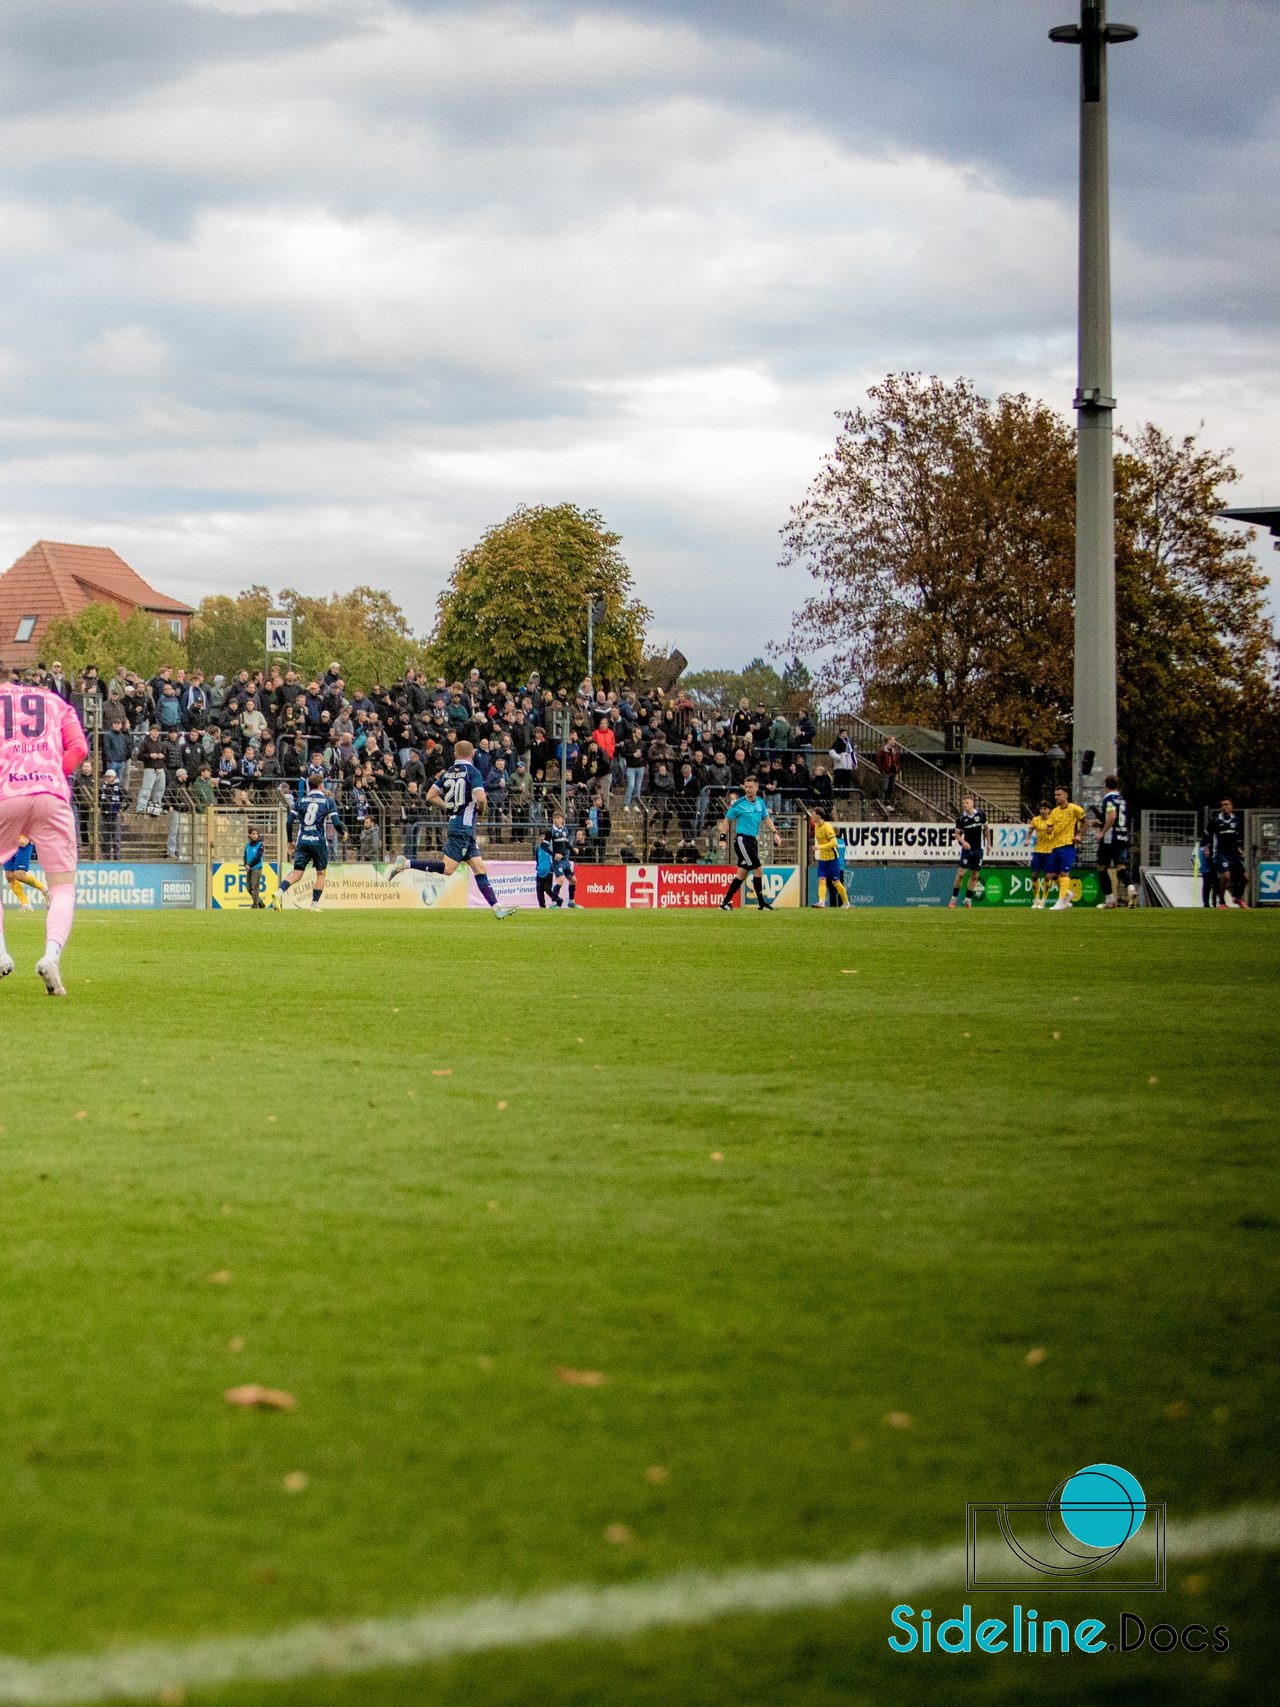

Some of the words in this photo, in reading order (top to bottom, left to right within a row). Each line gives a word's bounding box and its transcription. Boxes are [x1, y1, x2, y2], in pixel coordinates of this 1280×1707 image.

[272, 629, 286, 648] N
[9, 770, 54, 782] Katjes
[443, 778, 466, 809] 20
[304, 802, 319, 826] 8
[839, 827, 993, 848] AUFSTIEGSREF
[325, 879, 341, 888] Das
[342, 879, 401, 888] Mineralwasser
[488, 874, 522, 885] emokratie
[746, 873, 785, 899] SAP
[1025, 877, 1059, 892] DKA
[163, 883, 191, 893] RADIO
[587, 883, 615, 894] mbs.de
[324, 892, 338, 900] aus
[340, 890, 359, 900] dem
[360, 890, 401, 902] Naturpark
[661, 891, 690, 907] gibt's
[692, 891, 707, 905] bei
